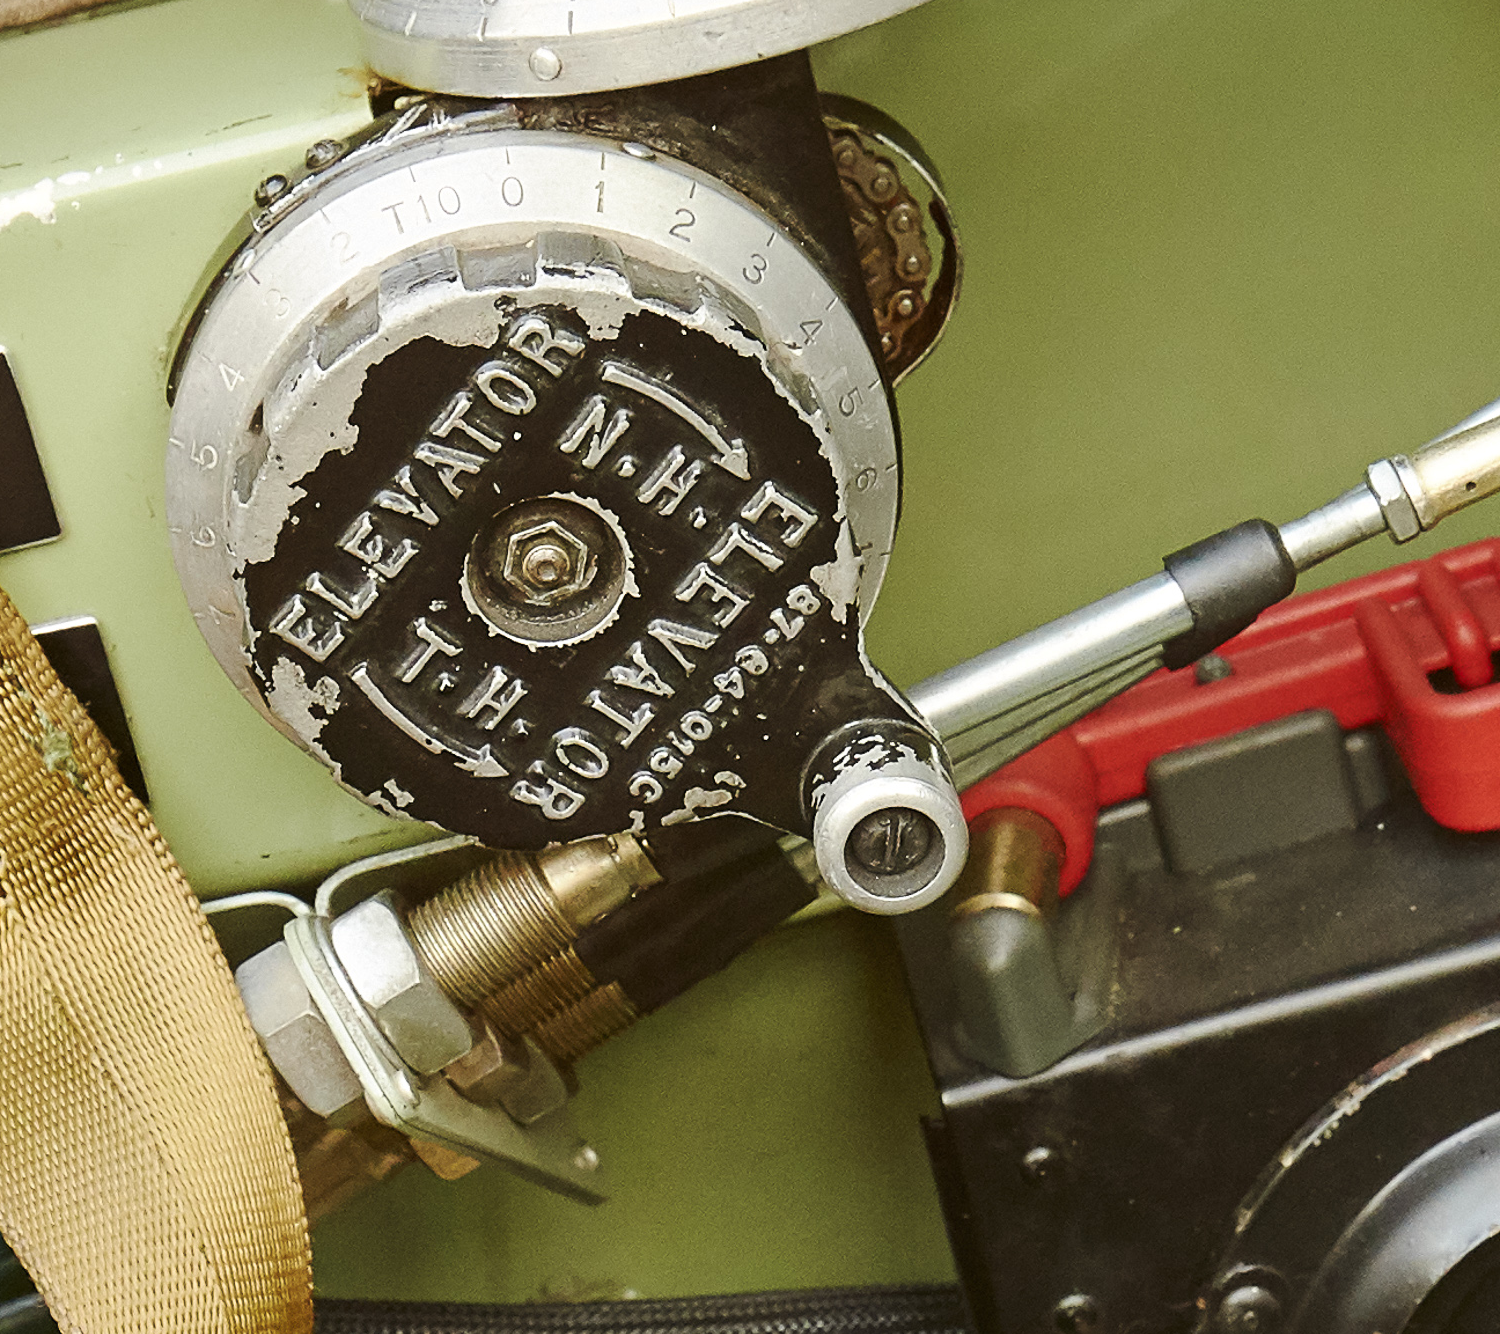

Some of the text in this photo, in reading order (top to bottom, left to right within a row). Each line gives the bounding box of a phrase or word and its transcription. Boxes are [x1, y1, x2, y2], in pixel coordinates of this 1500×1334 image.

[190, 443, 220, 471] 5
[218, 361, 245, 393] 4
[594, 179, 606, 214] 1
[668, 207, 697, 243] 2
[741, 253, 768, 285] 3
[799, 317, 824, 347] 4
[837, 386, 864, 419] 5
[854, 466, 877, 493] 6
[269, 314, 587, 664] ELEVATOR
[512, 479, 820, 822] ELEVATOR
